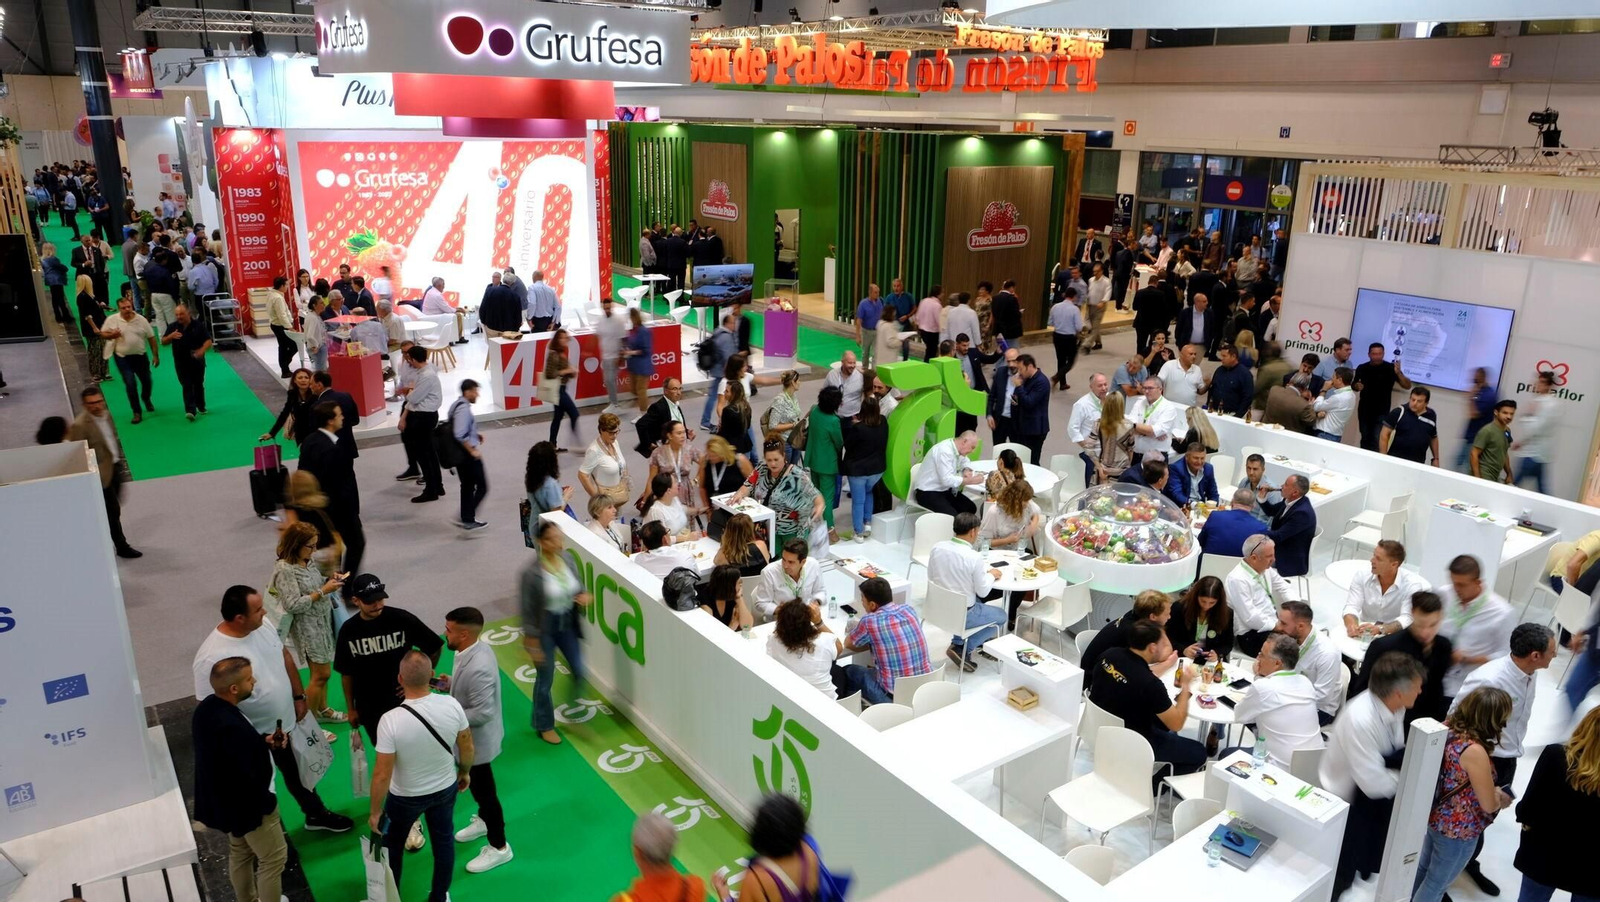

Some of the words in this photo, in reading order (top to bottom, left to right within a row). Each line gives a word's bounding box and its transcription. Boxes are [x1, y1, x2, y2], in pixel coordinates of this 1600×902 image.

[330, 15, 365, 49] Grufesa
[525, 23, 663, 66] Grufesa
[1031, 31, 1051, 53] de
[1057, 35, 1105, 59] Palos
[733, 37, 767, 84] de
[774, 32, 866, 86] Palos
[342, 79, 387, 107] Plus
[355, 167, 429, 189] Grufesa
[233, 187, 262, 198] 1983
[236, 212, 266, 223] 1990
[520, 189, 536, 271] aniversario
[970, 234, 997, 246] Fresón
[998, 233, 1007, 243] de
[1007, 231, 1026, 243] Palos
[239, 235, 268, 246] 1996
[242, 260, 271, 271] 2001
[1457, 310, 1468, 318] 24
[1285, 339, 1335, 355] primaflor
[1516, 382, 1585, 402] priaflor
[61, 727, 87, 742] IFS
[9, 789, 31, 806] AB
